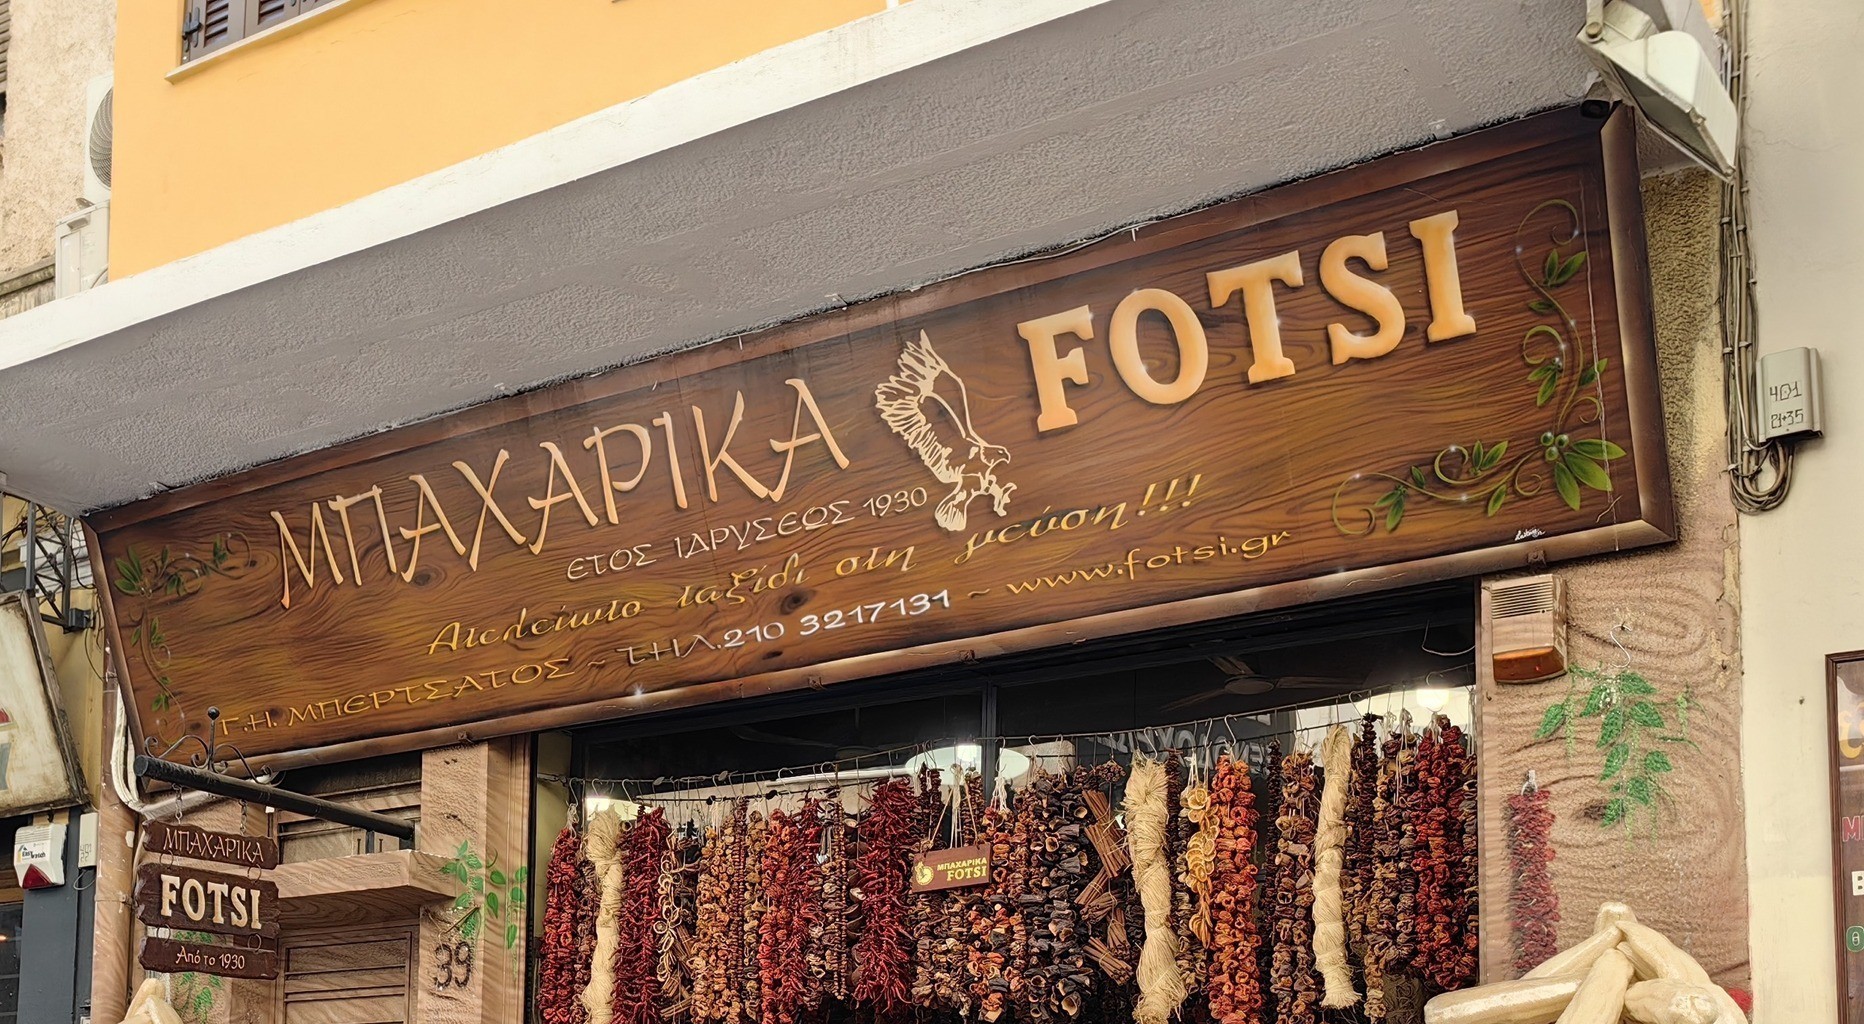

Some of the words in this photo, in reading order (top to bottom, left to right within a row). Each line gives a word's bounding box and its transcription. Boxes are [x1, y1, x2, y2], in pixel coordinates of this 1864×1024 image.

[1016, 209, 1478, 433] FOTSI
[269, 376, 852, 610] ΜΠΑΧΑΡΙΚΑ
[566, 543, 657, 580] ΕΤΟΣ
[675, 499, 857, 561] ΙΔΡΥΣΕΩΣ
[863, 486, 929, 519] 1930
[287, 657, 576, 727] ΜΠΕΡΤΣΑΤΟΣ
[799, 588, 950, 636] 3217131
[1006, 528, 1291, 595] www.fotsi.gr
[163, 827, 264, 864] ΜΠΑΧΑΡΙΚΑ
[937, 857, 987, 871] ΜΠΑΧΑΡΙΚΑ
[946, 866, 987, 881] FOTSI
[160, 873, 262, 930] FOTSI
[175, 945, 201, 964] Από
[204, 954, 216, 966] το
[218, 953, 245, 969] 1930
[432, 941, 471, 988] 39
